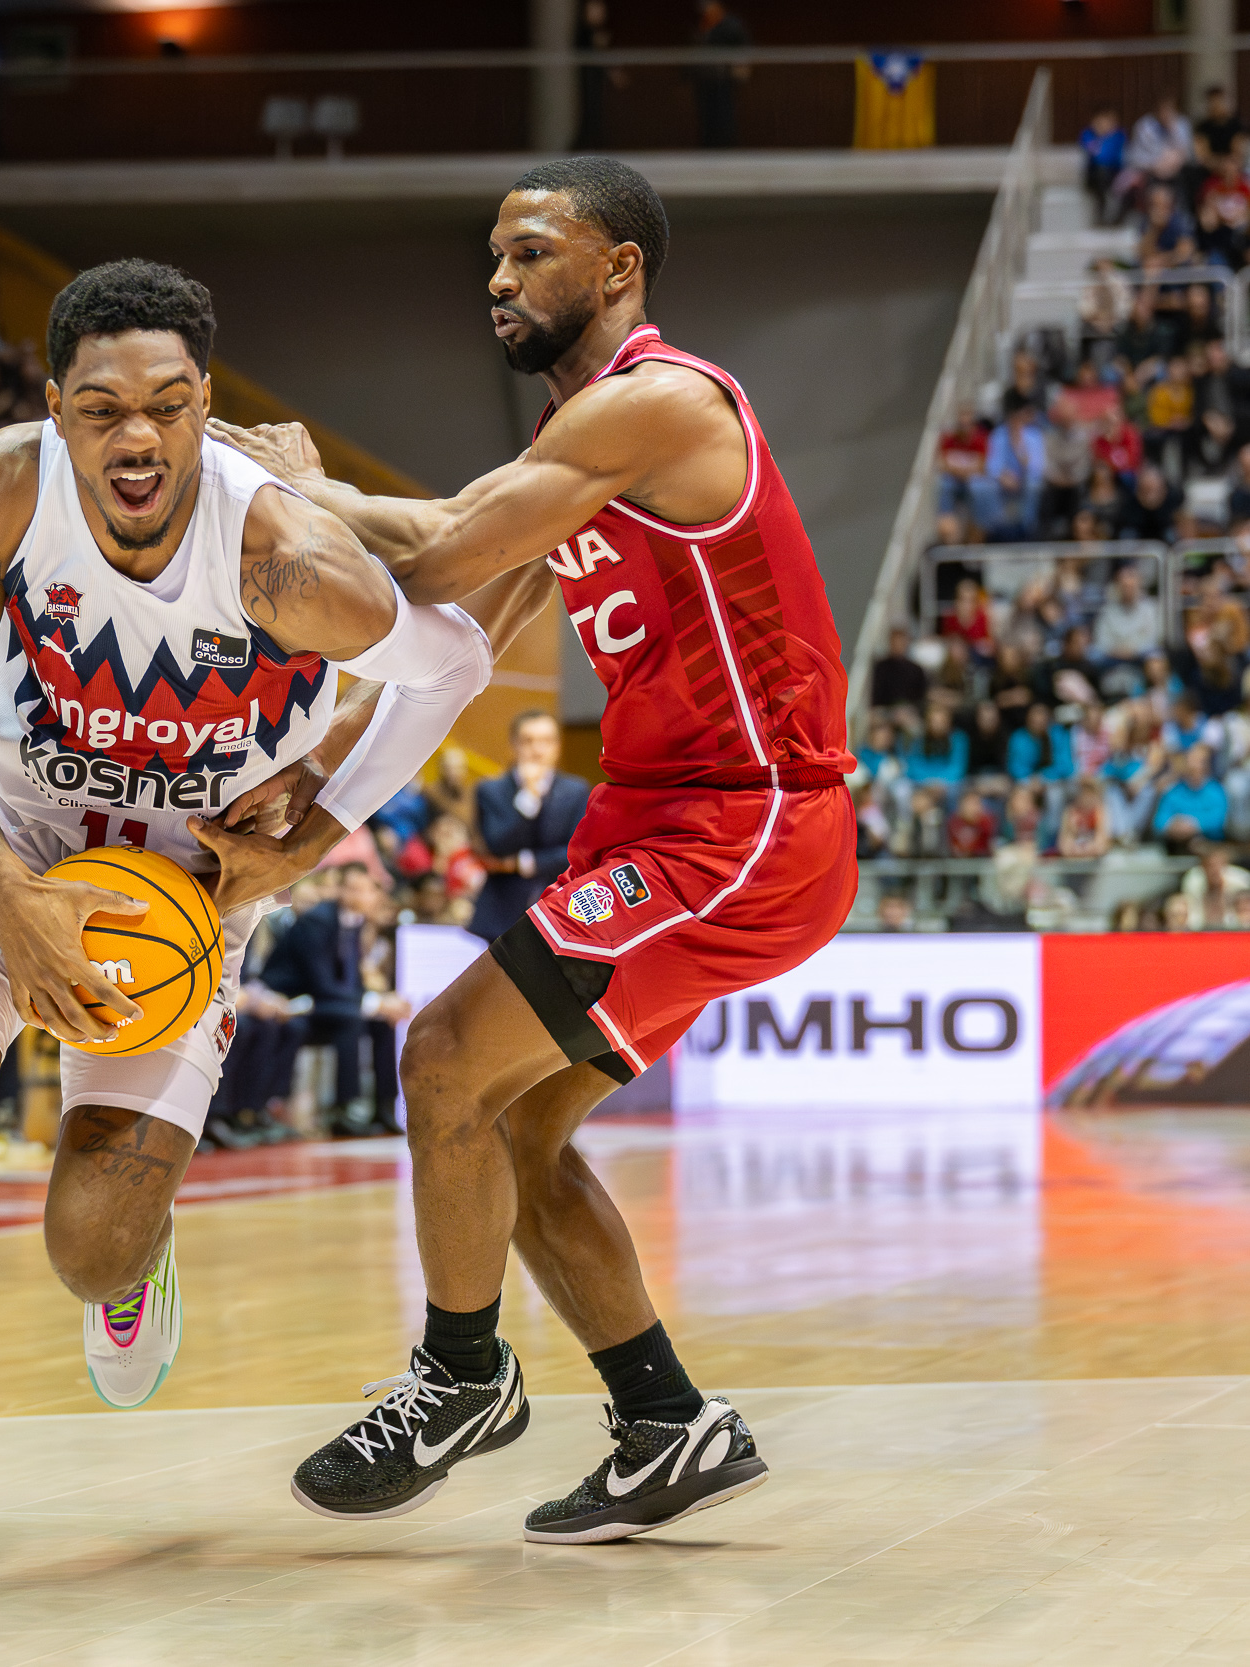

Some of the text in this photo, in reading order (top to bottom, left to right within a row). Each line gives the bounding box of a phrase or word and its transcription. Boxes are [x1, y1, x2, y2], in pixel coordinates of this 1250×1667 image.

[195, 650, 243, 664] endesa
[196, 639, 218, 652] liga
[615, 870, 635, 897] acb
[572, 891, 597, 924] GIRONA
[583, 888, 605, 916] BASQUET
